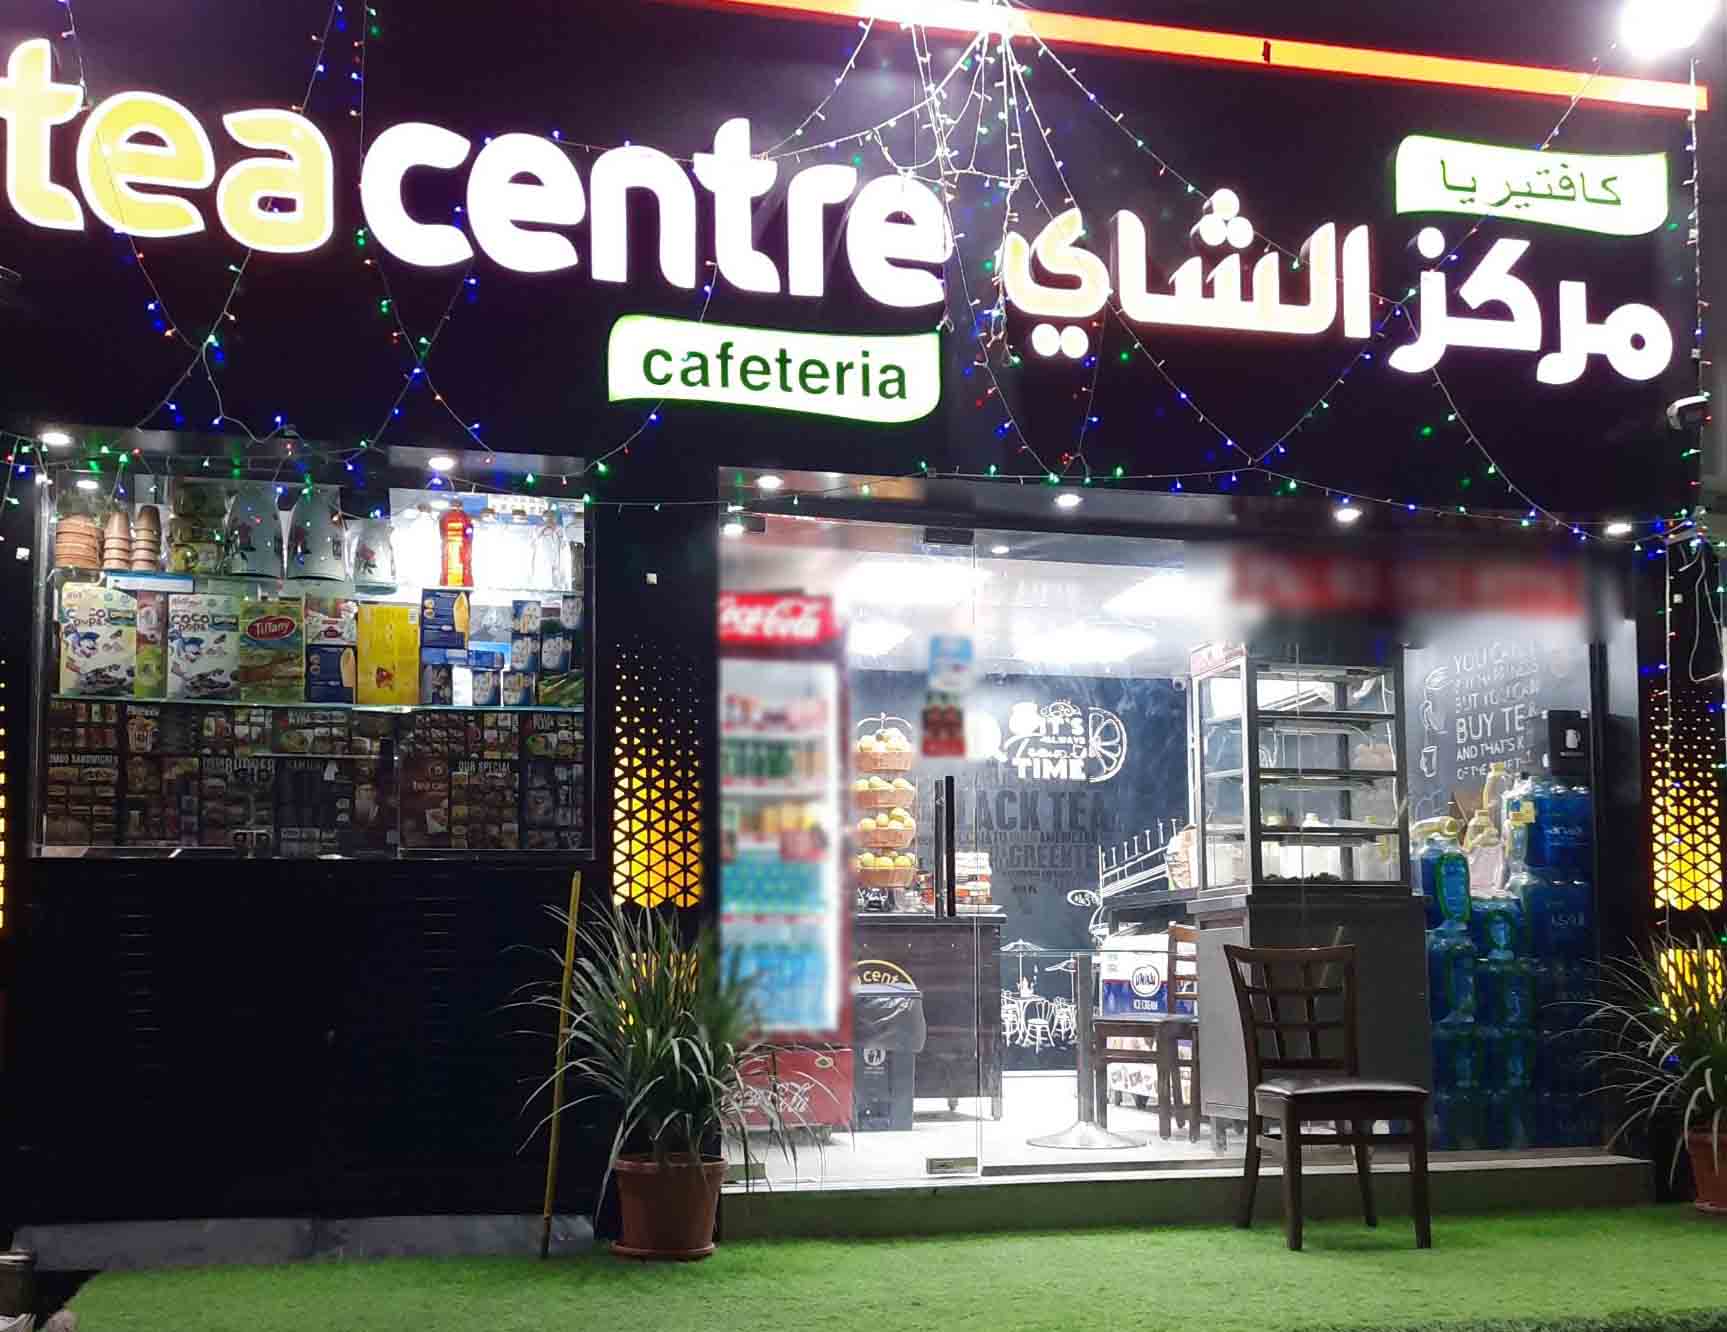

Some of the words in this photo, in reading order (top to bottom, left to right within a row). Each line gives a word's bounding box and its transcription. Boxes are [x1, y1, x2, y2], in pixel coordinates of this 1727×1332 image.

[0, 38, 334, 253] tea
[361, 117, 953, 308] centre
[1440, 157, 1623, 208] كافتيريا
[1003, 187, 1371, 358] الشاي
[1388, 226, 1674, 385] مركز
[641, 341, 908, 400] cafeteria
[1456, 712, 1494, 744] BUY
[1501, 702, 1536, 734] TEA
[1012, 758, 1087, 780] TIME
